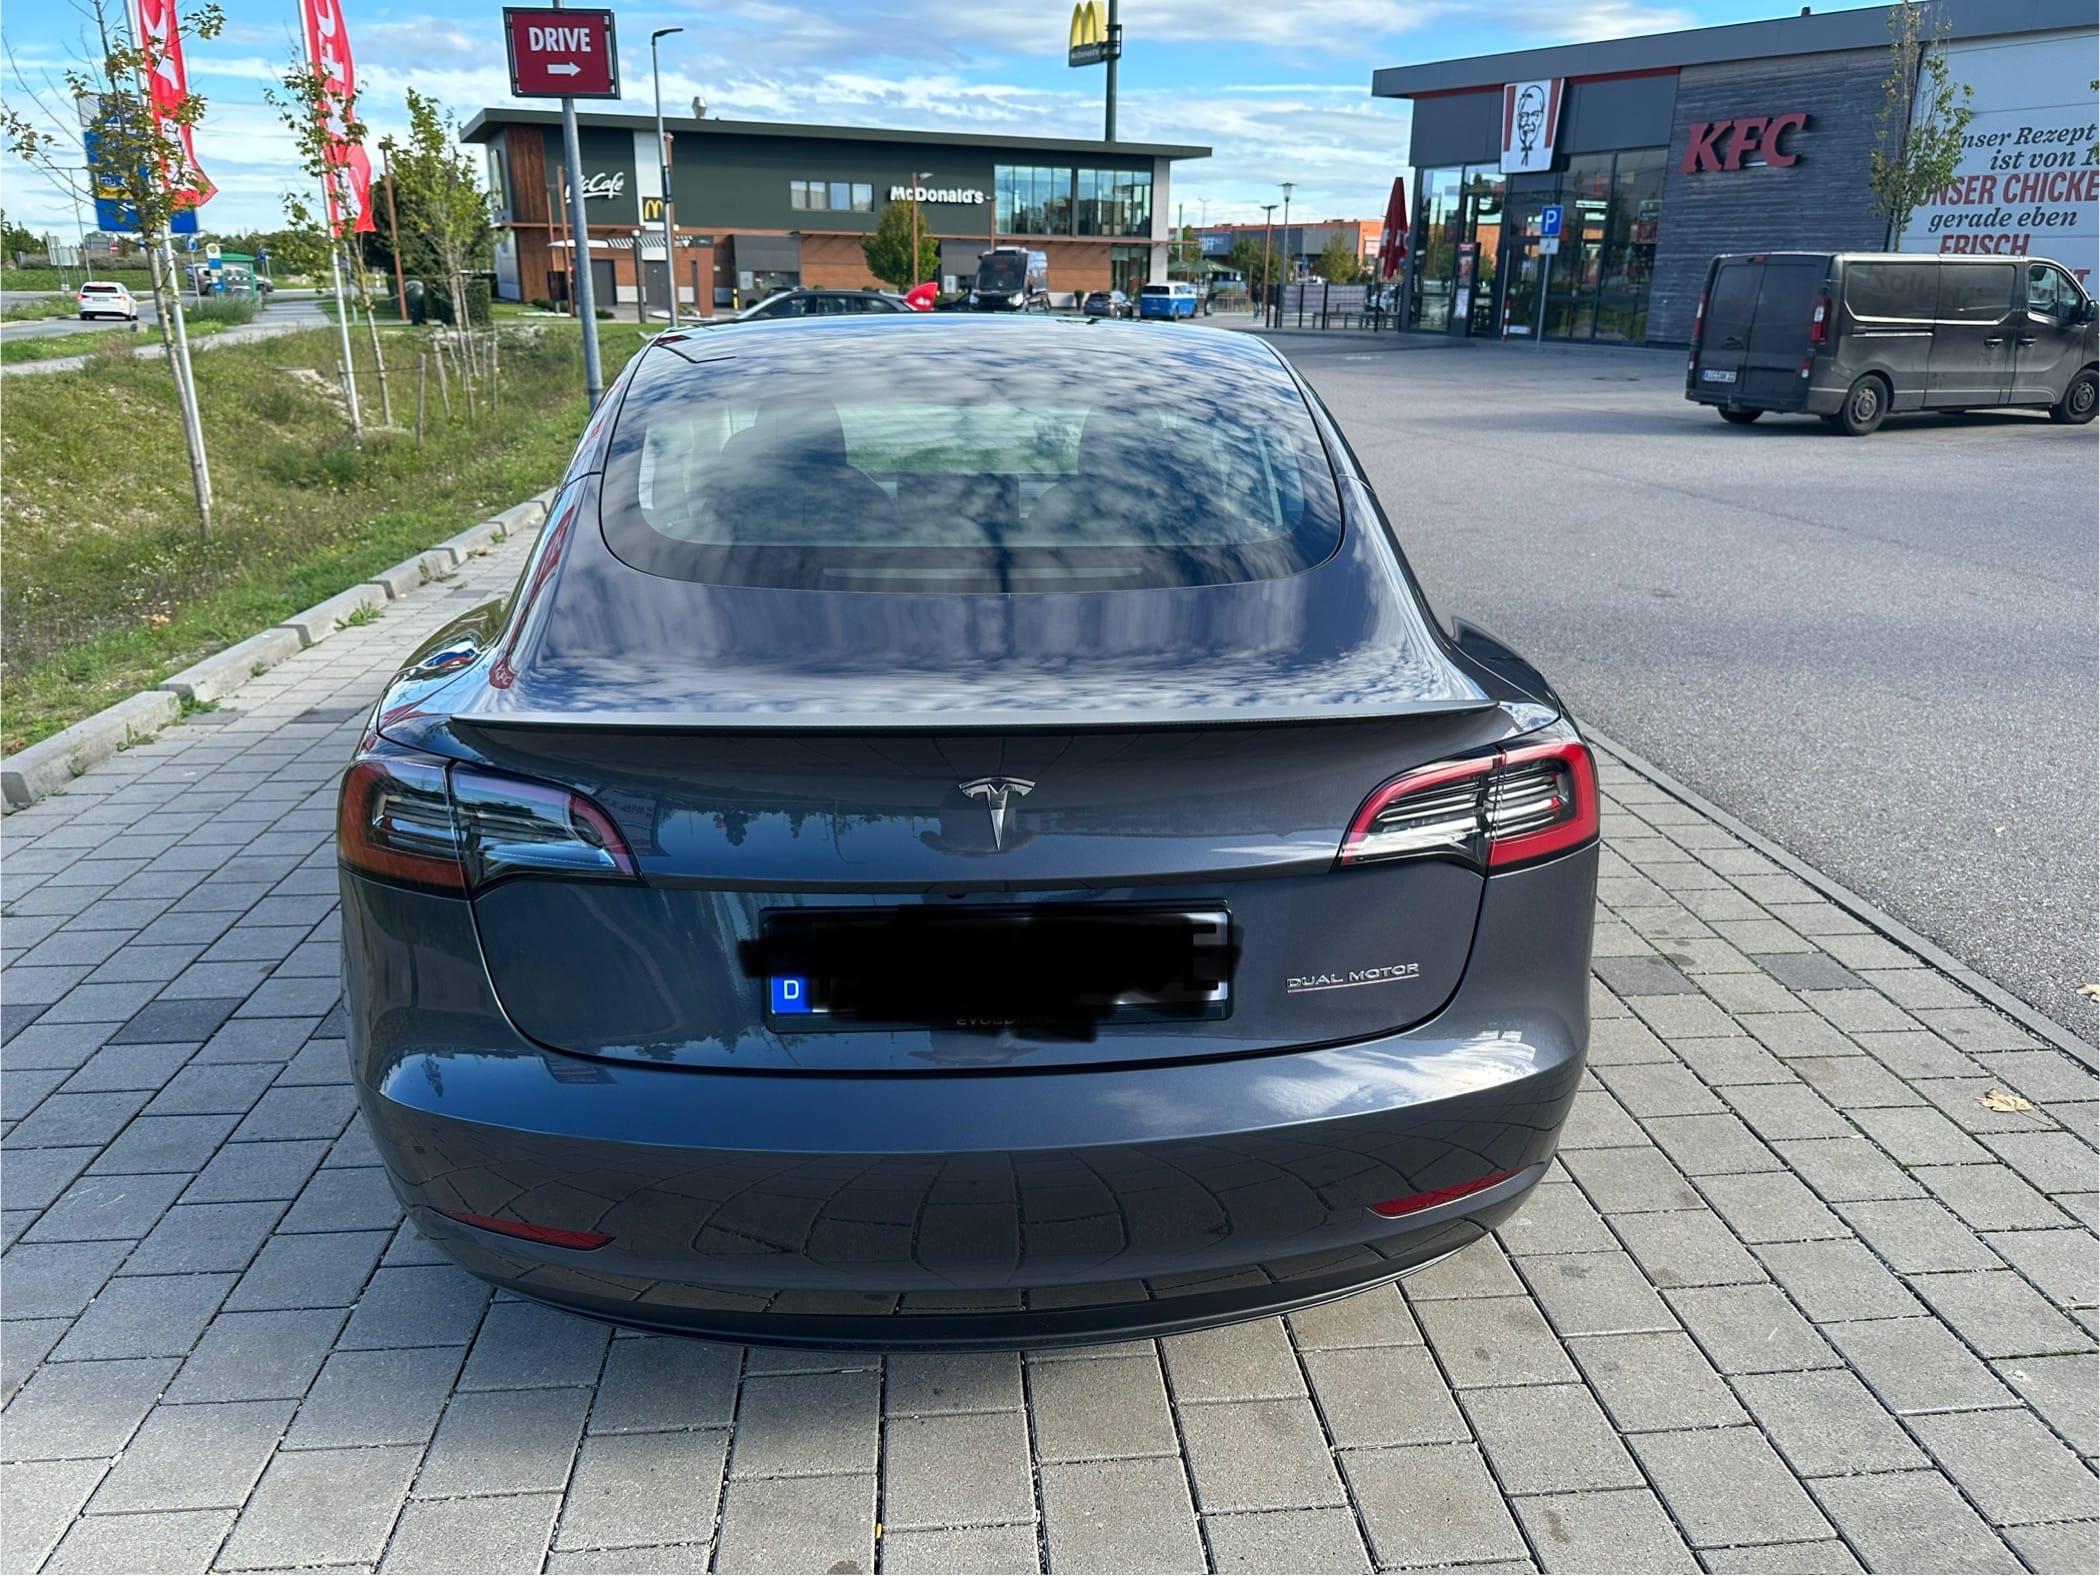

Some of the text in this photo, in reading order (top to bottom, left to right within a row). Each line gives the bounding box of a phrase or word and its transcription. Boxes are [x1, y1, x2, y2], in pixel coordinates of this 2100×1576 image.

[528, 27, 592, 52] DRIVE
[1678, 112, 1807, 173] KFC
[1958, 123, 2098, 148] nser Rezept
[1990, 149, 2024, 170] ist
[2029, 150, 2076, 169] von
[890, 186, 984, 204] McDonald's
[1544, 210, 1558, 232] P
[1928, 206, 2077, 233] gerade eben
[1941, 233, 2030, 255] FRISCH
[1287, 963, 1419, 988] DUAL MOTOR
[783, 980, 799, 1000] D
